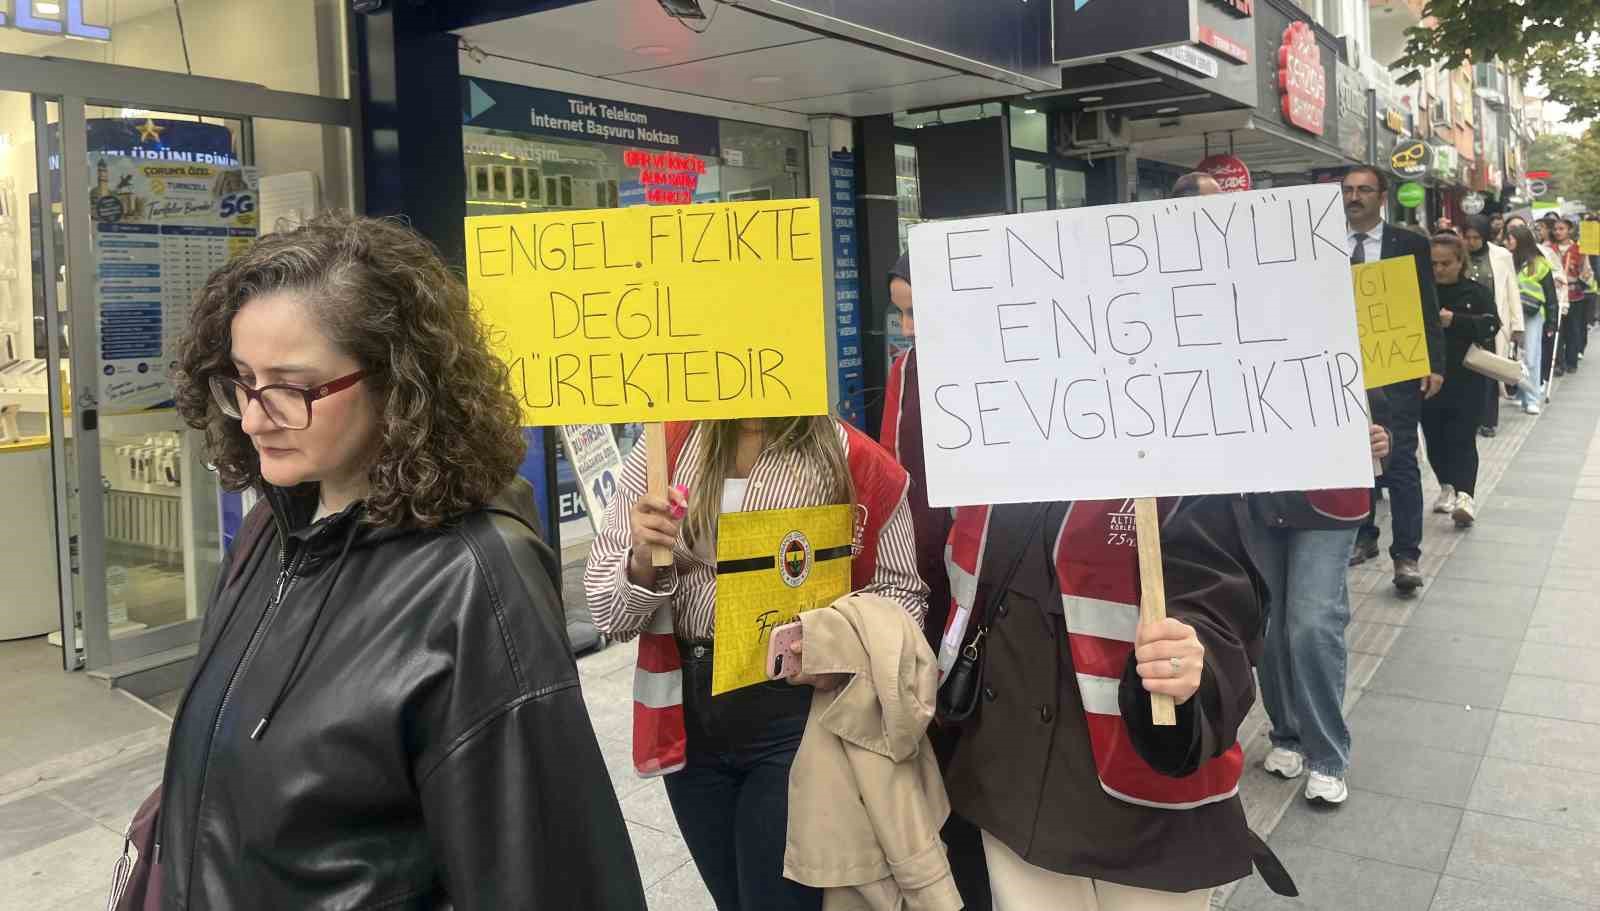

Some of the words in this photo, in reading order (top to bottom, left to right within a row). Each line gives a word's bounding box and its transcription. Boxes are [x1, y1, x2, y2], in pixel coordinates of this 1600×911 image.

[530, 108, 584, 132] İnternet
[587, 119, 635, 140] Başvuru
[637, 128, 679, 145] Noktası
[567, 99, 597, 117] Türk
[600, 104, 648, 124] Telekom
[220, 194, 255, 218] 5G
[1217, 175, 1246, 190] ZADE
[476, 219, 634, 278] ENGEL
[650, 206, 815, 265] FİZİKTE
[946, 219, 1065, 292] EN
[1105, 190, 1350, 278] BÜYÜK
[549, 280, 704, 340] DEĞİL
[996, 282, 1289, 363] ENGEL
[934, 350, 1369, 450] SEVGİSİZLİKTİR
